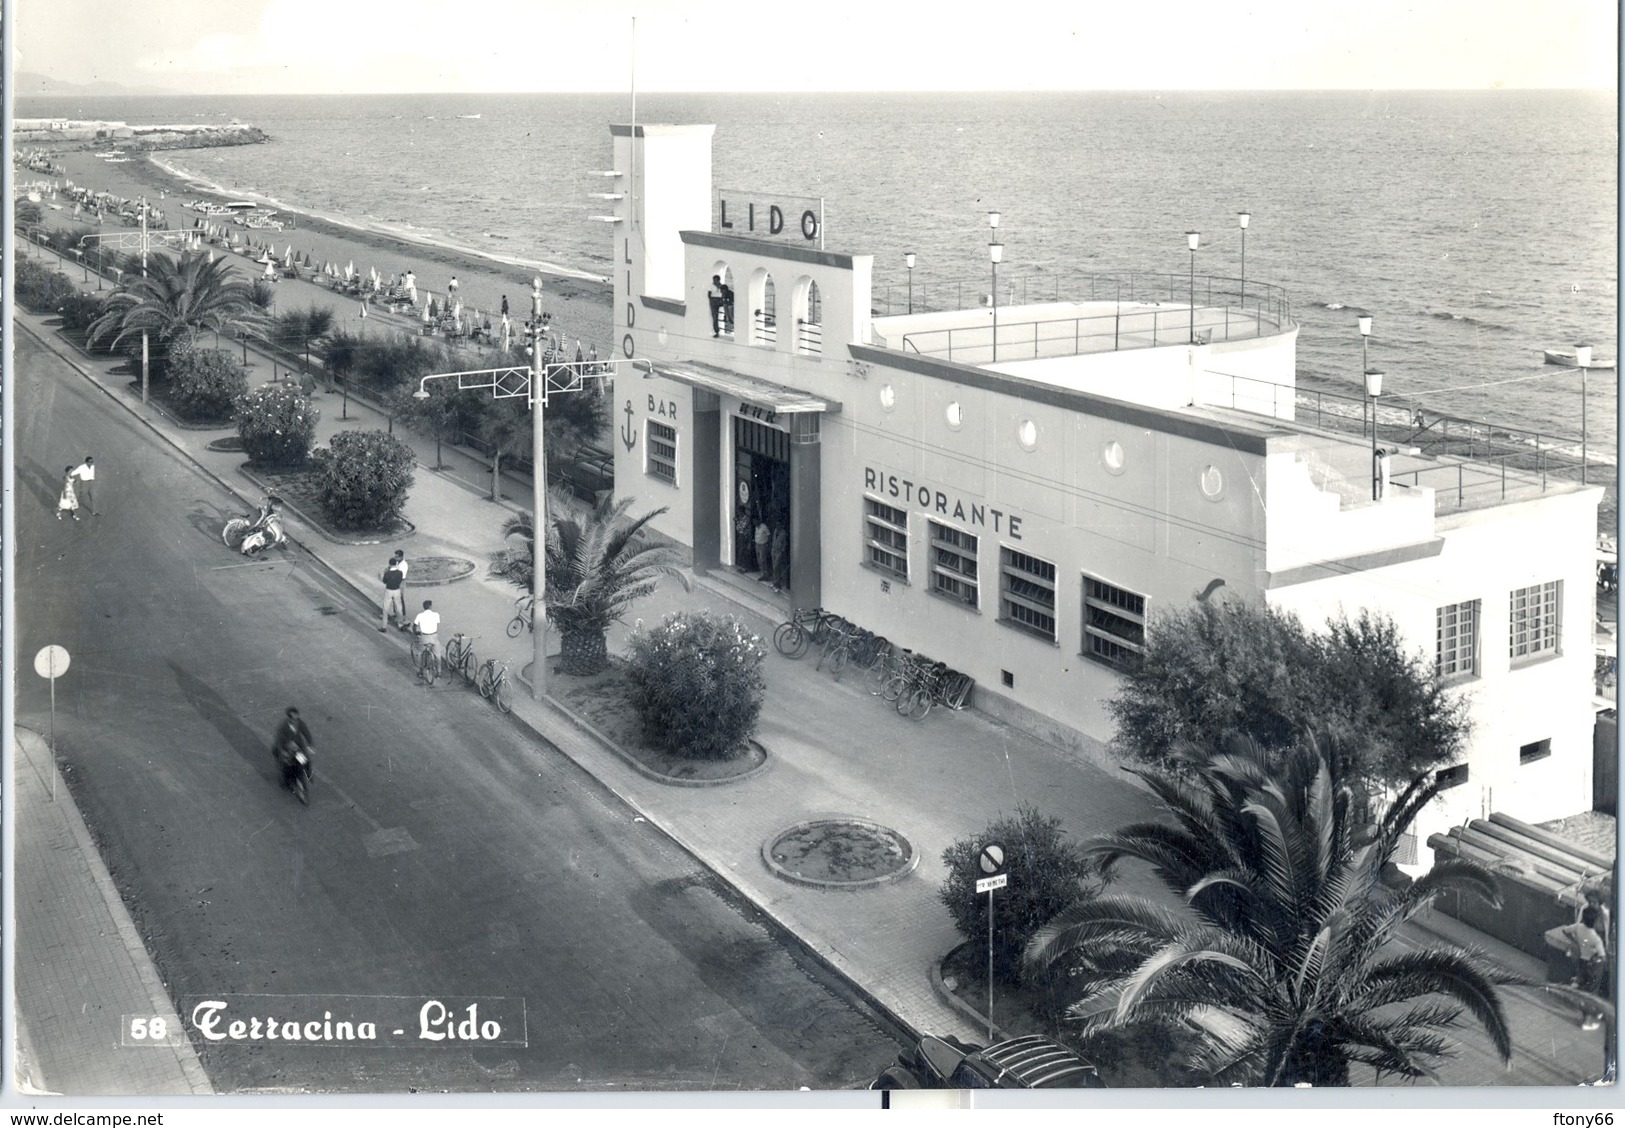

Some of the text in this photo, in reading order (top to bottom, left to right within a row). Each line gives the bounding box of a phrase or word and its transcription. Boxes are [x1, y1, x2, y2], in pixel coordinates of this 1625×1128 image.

[721, 199, 818, 241] LIDO
[622, 237, 636, 359] LIDO
[647, 393, 678, 420] BAR
[864, 466, 1023, 541] RISTORANTE
